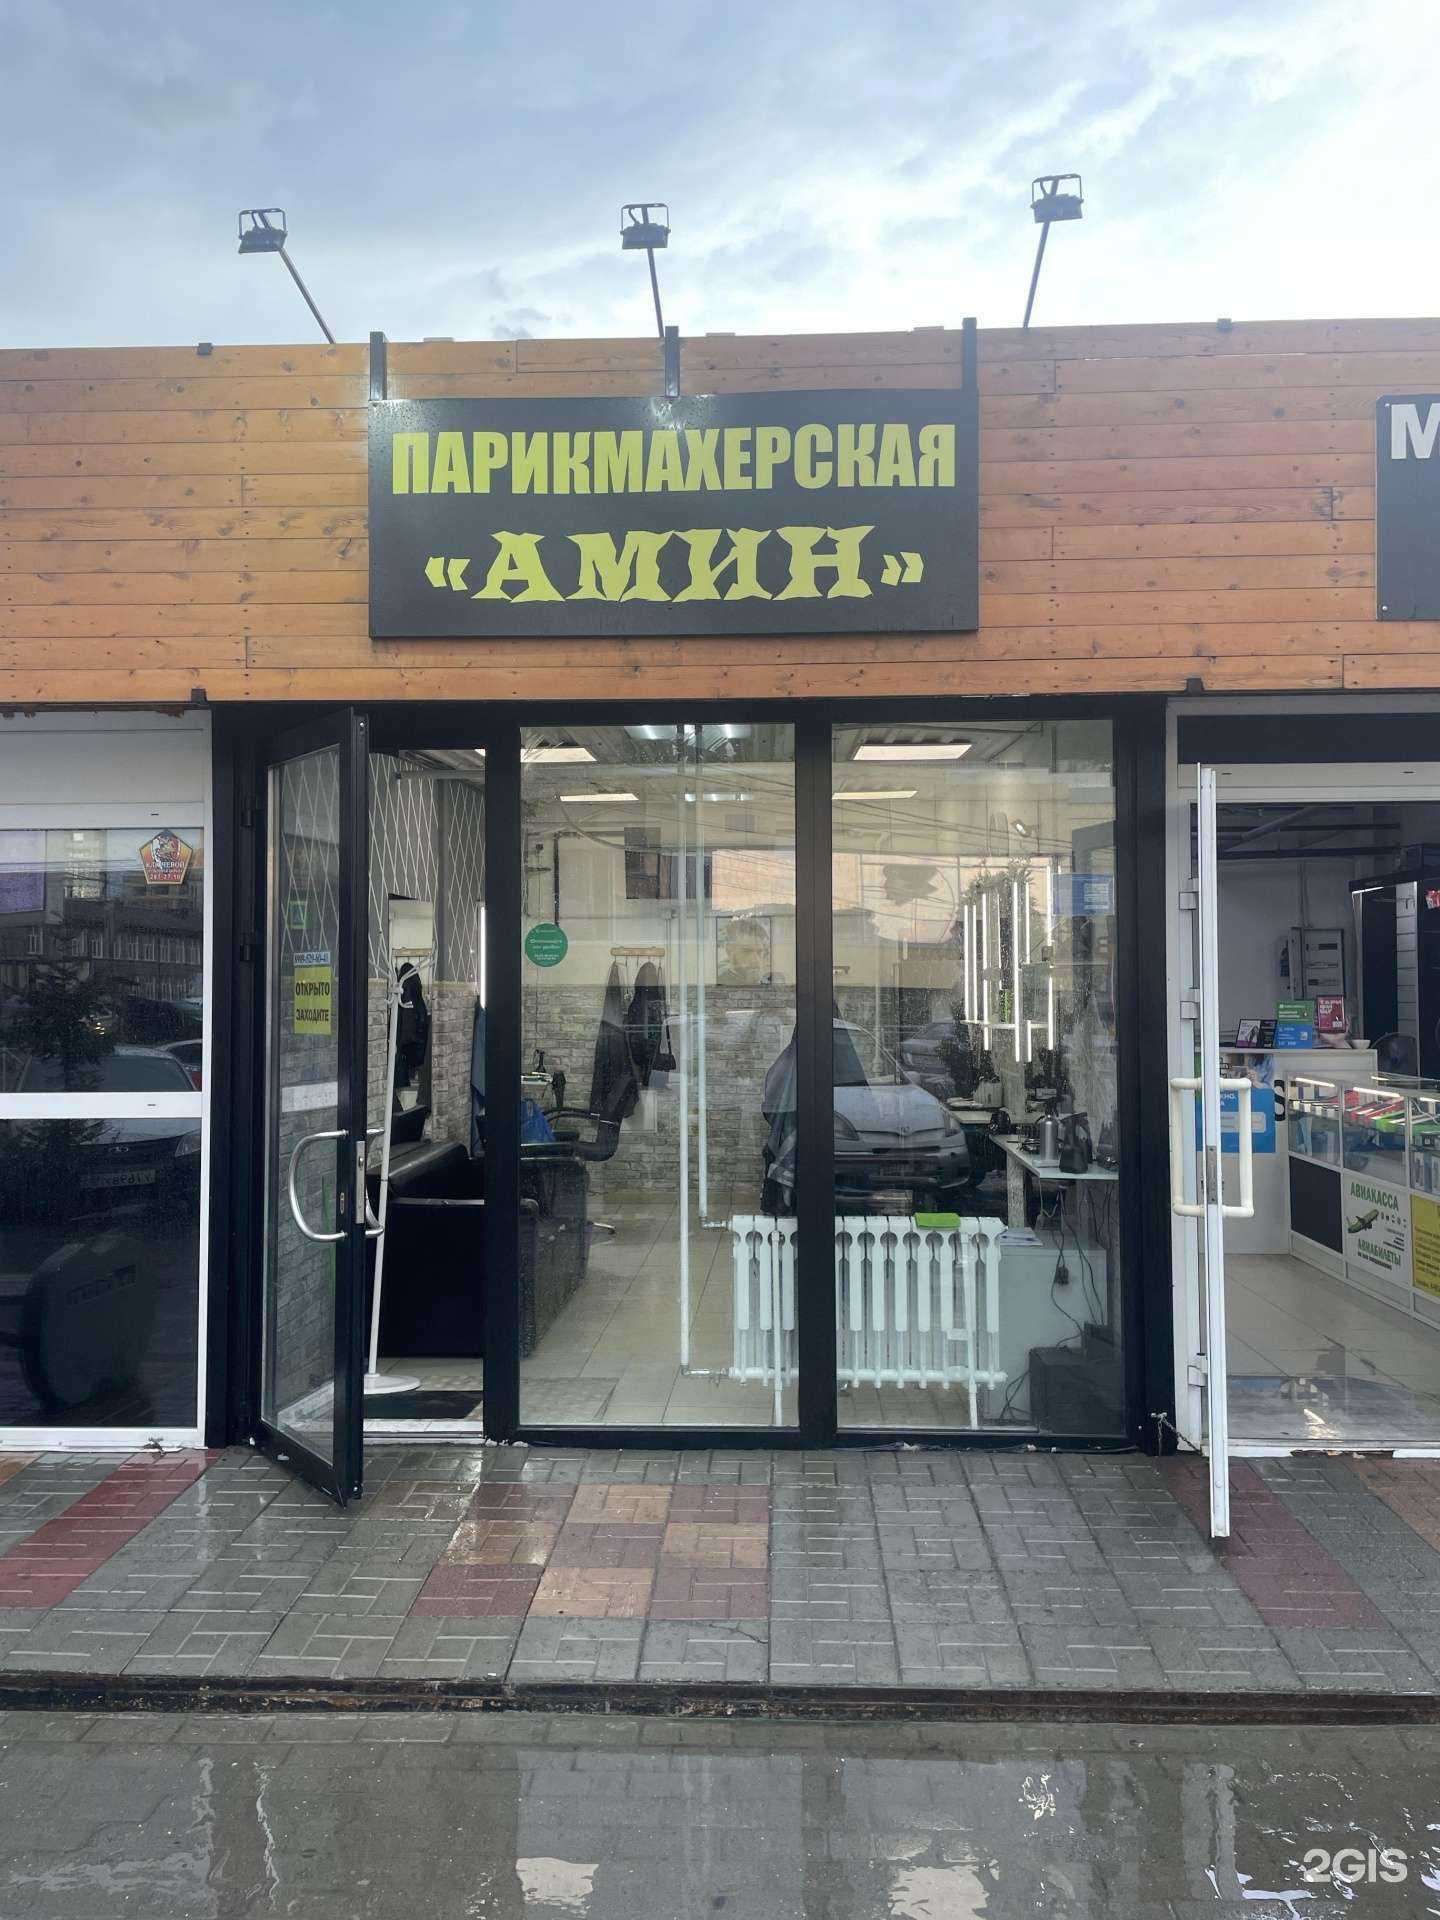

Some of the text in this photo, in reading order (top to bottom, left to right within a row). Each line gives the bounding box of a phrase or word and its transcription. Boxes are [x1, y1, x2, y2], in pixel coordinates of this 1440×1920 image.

[392, 424, 956, 495] ПАРИКМАХЕРСКАЯ
[424, 525, 925, 602] «АМИН»
[295, 982, 330, 996] ОТКРЫТО
[296, 1009, 330, 1023] ЗАХОДИТЕ
[1350, 1182, 1399, 1211] АВИАКАССА
[1358, 1238, 1401, 1266] АВИАБИЛЕТЫ
